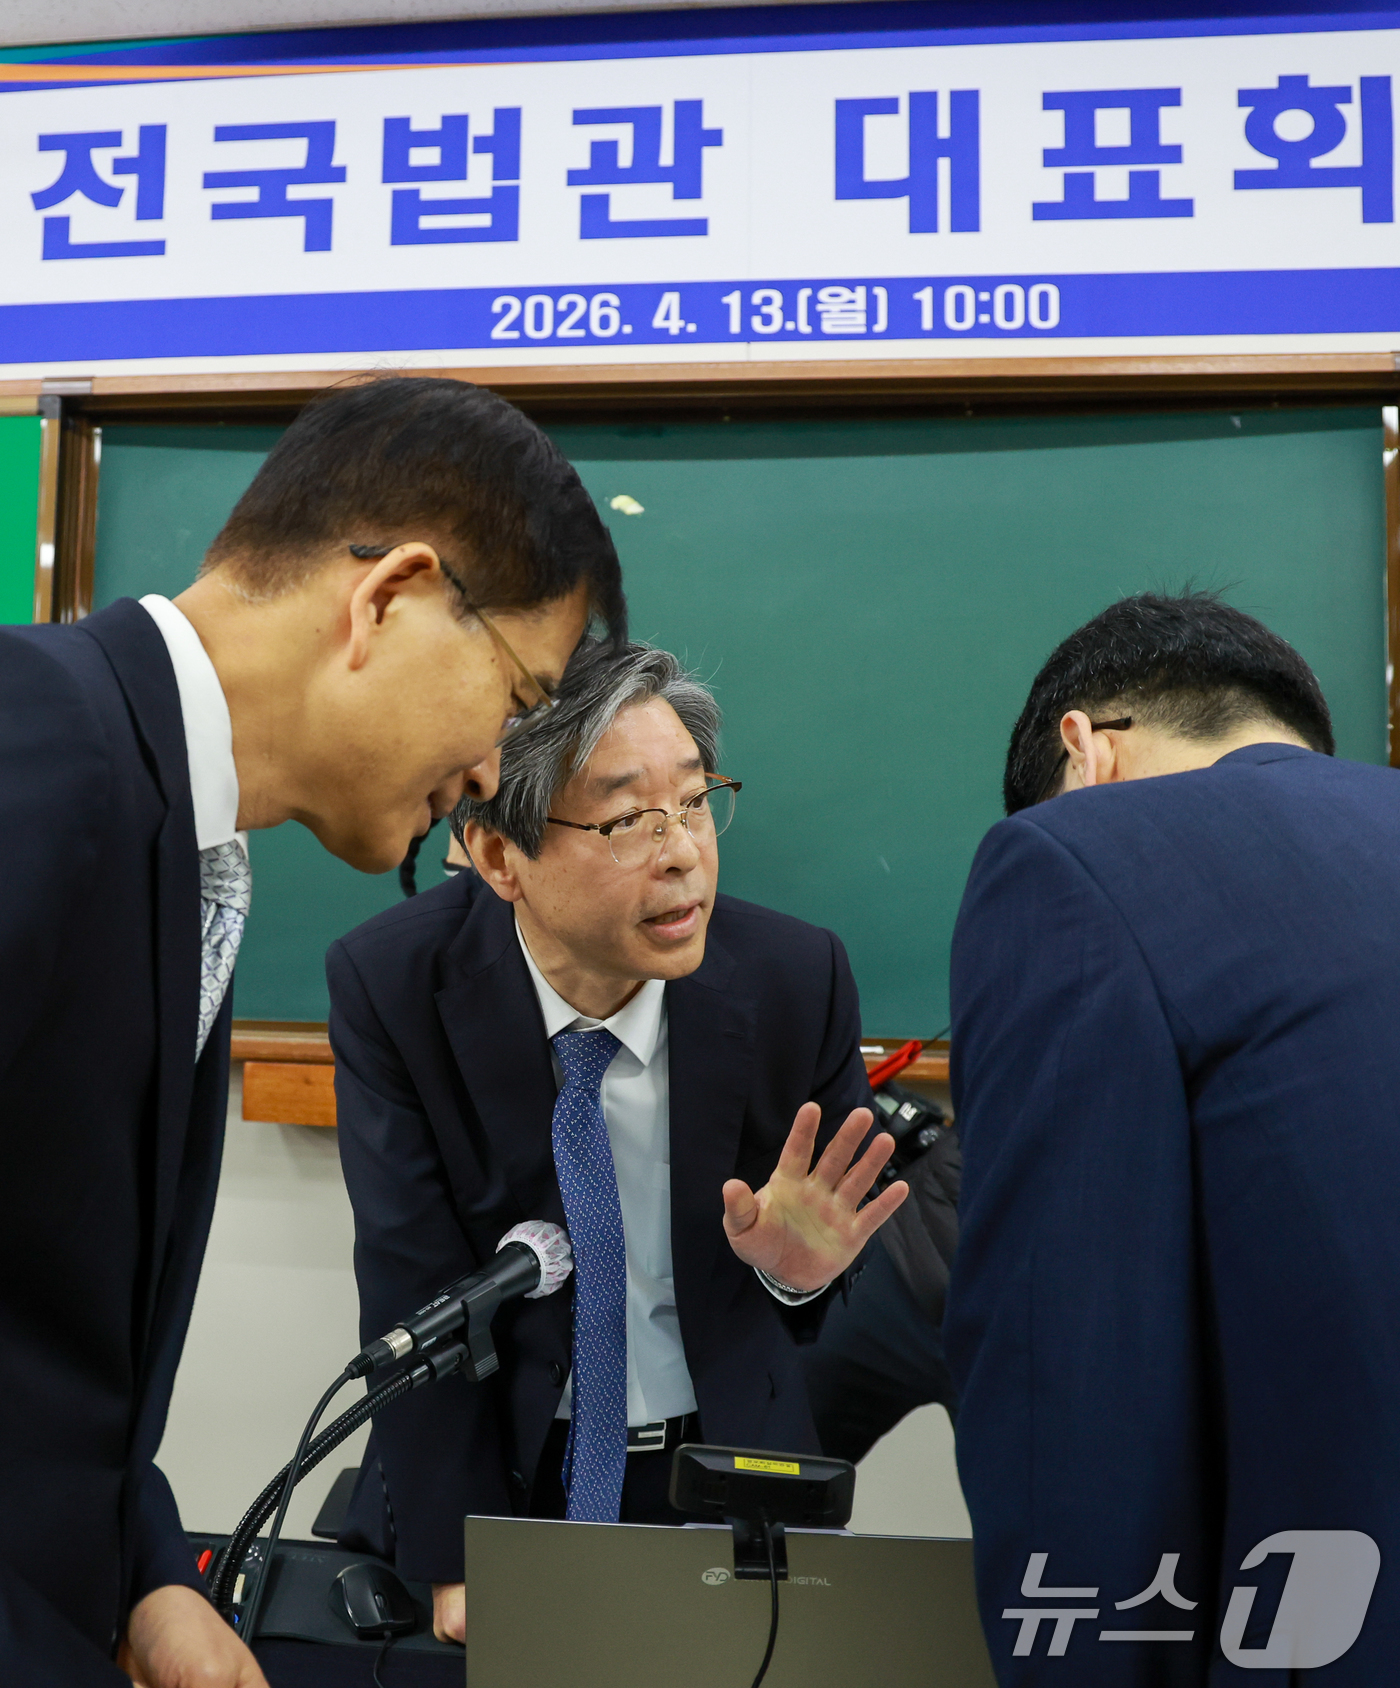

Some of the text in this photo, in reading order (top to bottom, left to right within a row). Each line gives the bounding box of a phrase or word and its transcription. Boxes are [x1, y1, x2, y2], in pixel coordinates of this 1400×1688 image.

[30, 74, 1395, 261] 전국법관 대표회
[490, 283, 1061, 340] 2026. 4. 13.(월) 10:00
